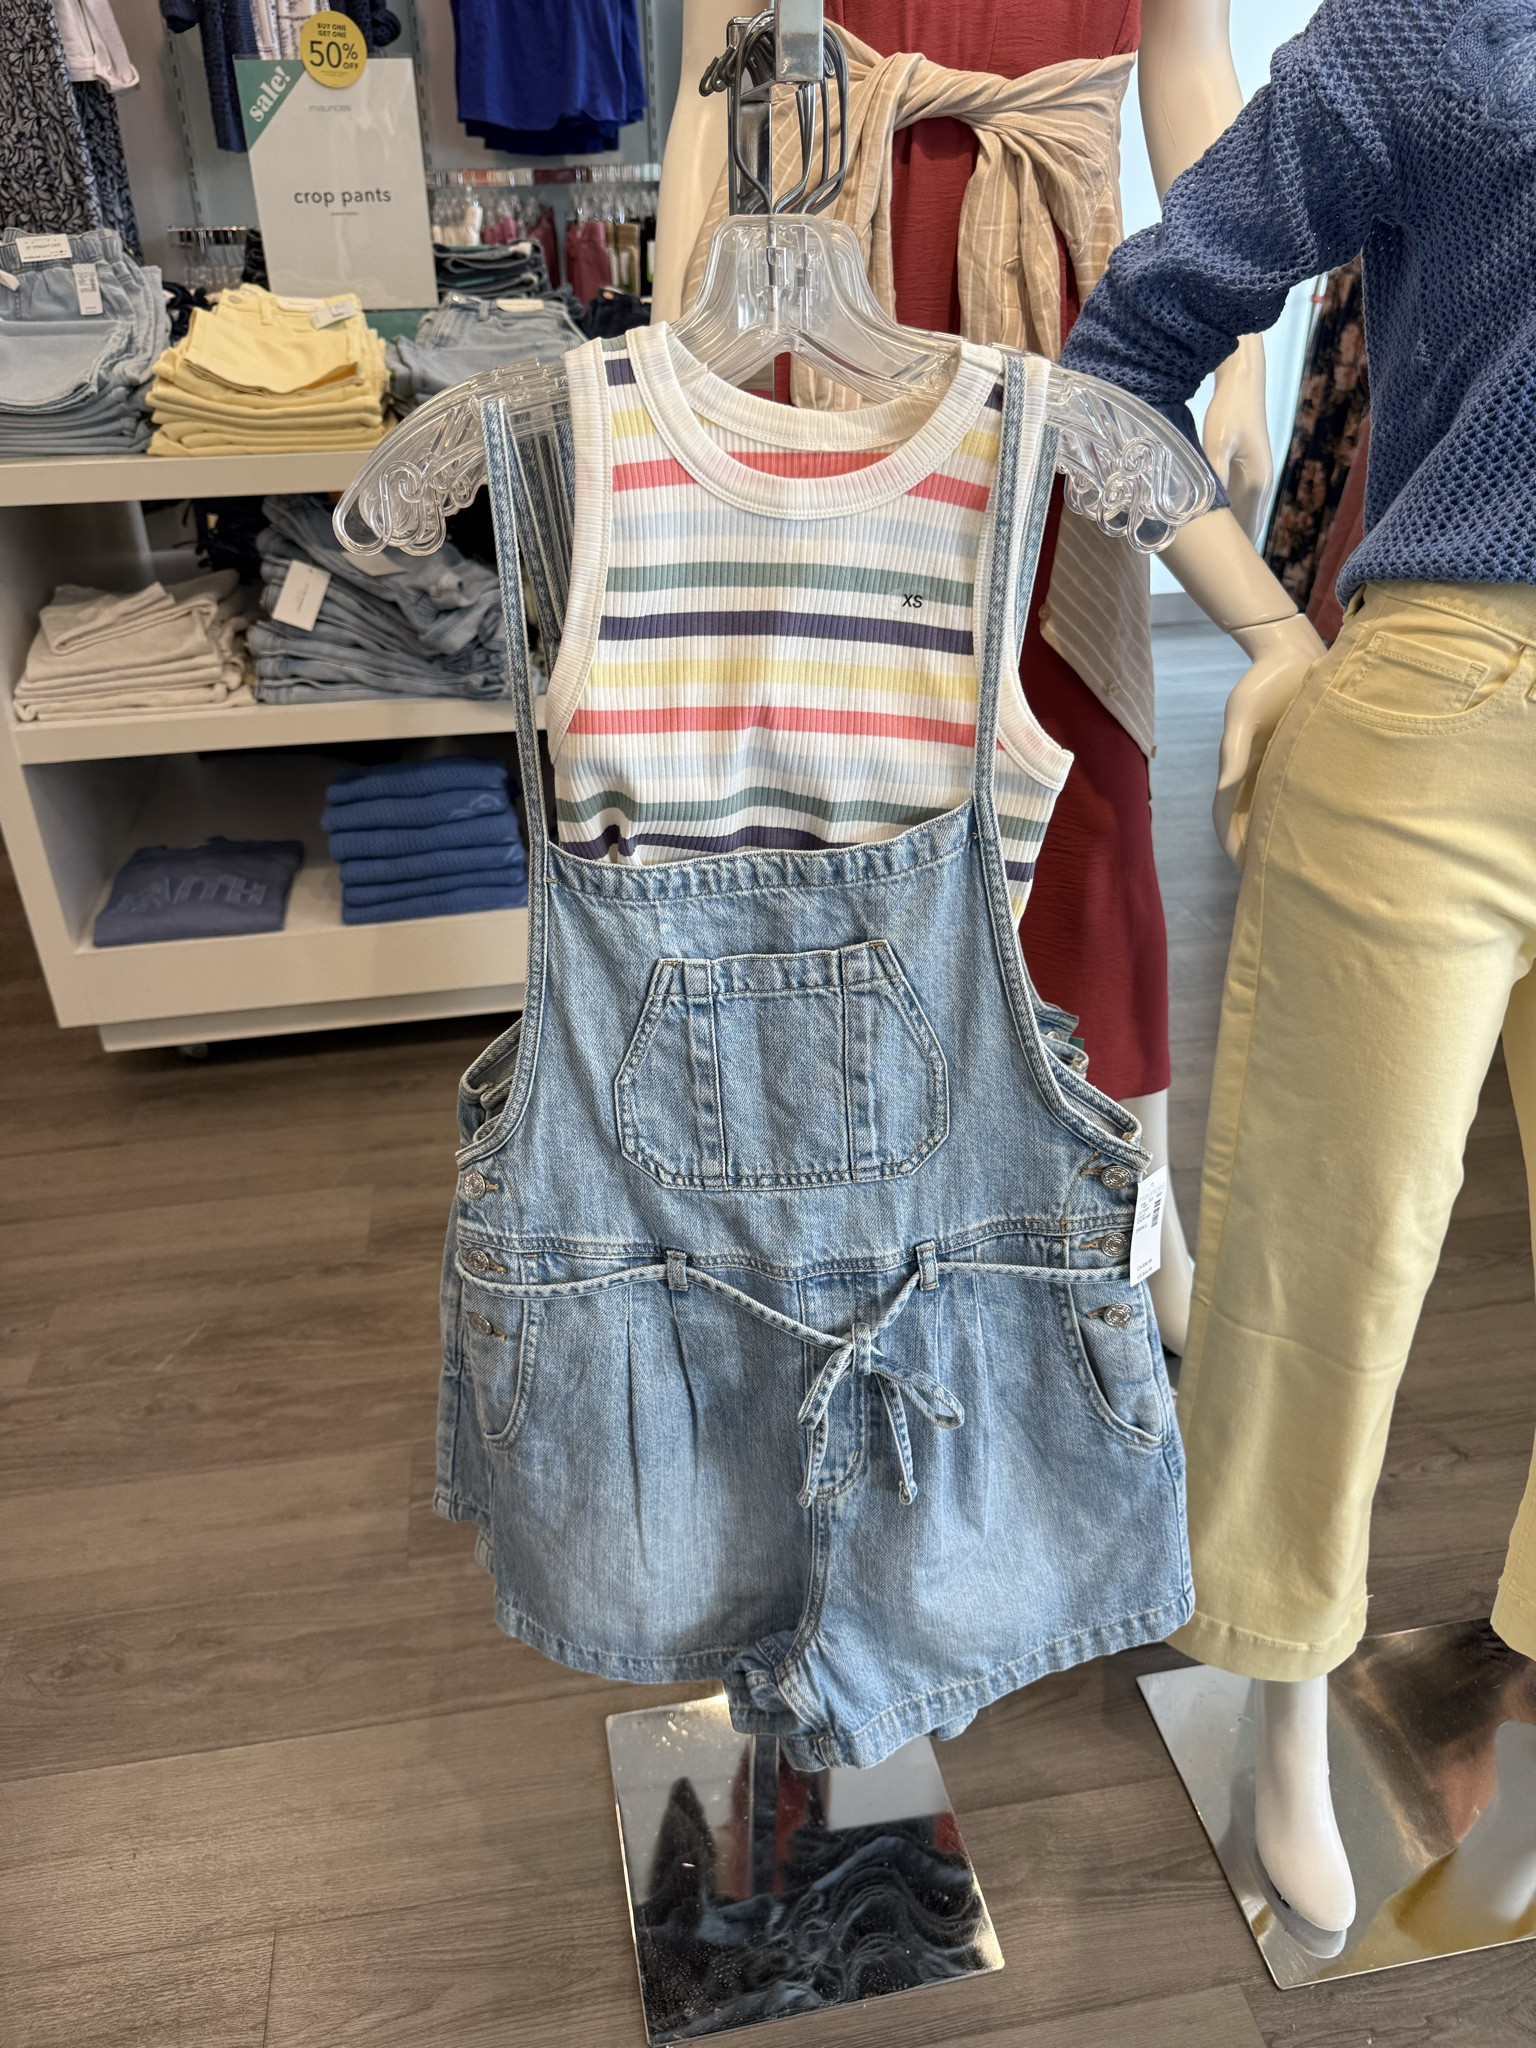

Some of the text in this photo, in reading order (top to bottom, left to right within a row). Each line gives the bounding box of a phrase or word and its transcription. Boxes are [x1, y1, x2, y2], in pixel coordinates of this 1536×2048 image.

[331, 23, 346, 31] ONE
[309, 40, 358, 68] 50%
[342, 61, 359, 70] OFF
[249, 65, 291, 122] sale!
[294, 187, 391, 208] crop pants
[902, 594, 923, 608] XS
